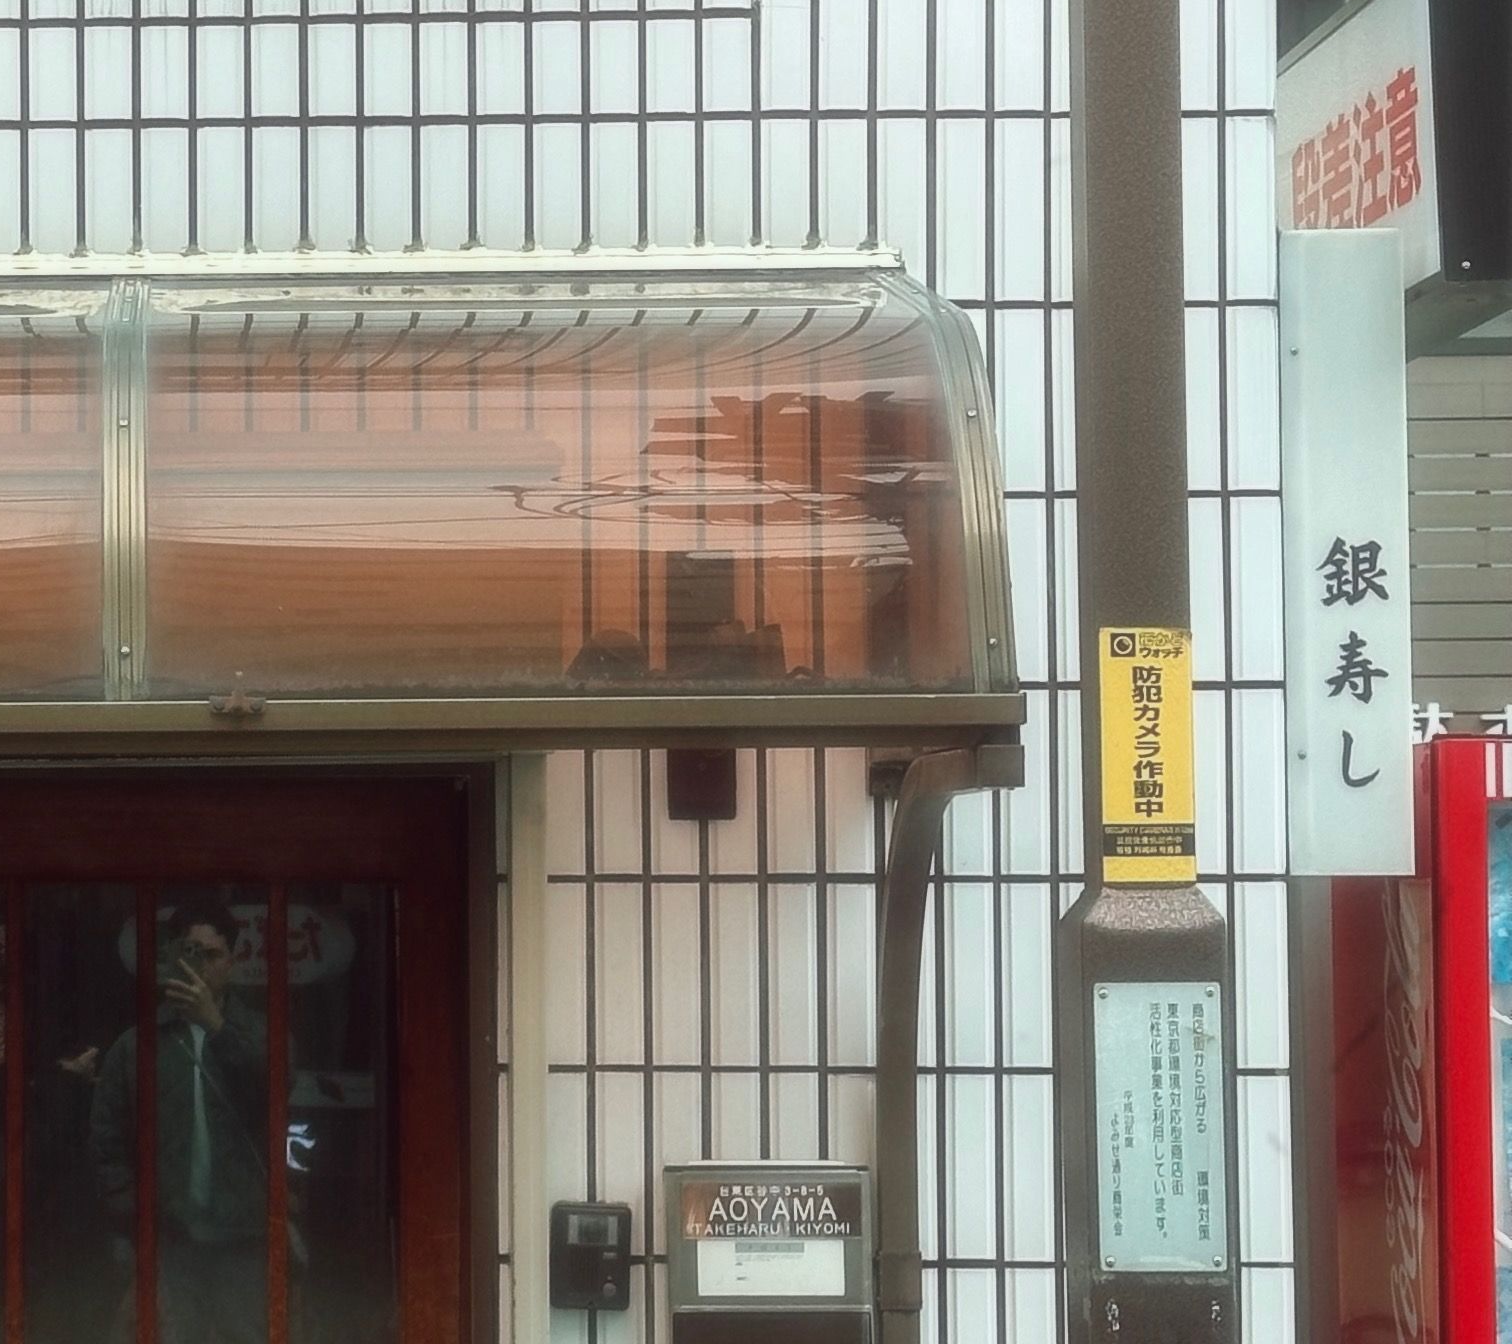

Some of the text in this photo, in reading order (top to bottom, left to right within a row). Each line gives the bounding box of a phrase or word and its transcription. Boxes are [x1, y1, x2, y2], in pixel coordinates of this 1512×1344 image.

[1315, 536, 1390, 788] 銀寿し
[1131, 665, 1165, 818] 防犯カメラ作動中
[1167, 1002, 1184, 1196] 東京都環境対応型商店街
[1192, 1002, 1208, 1134] 商店街から広がる
[708, 1197, 837, 1222] AOYAMA
[795, 1222, 851, 1235] KIYOMI
